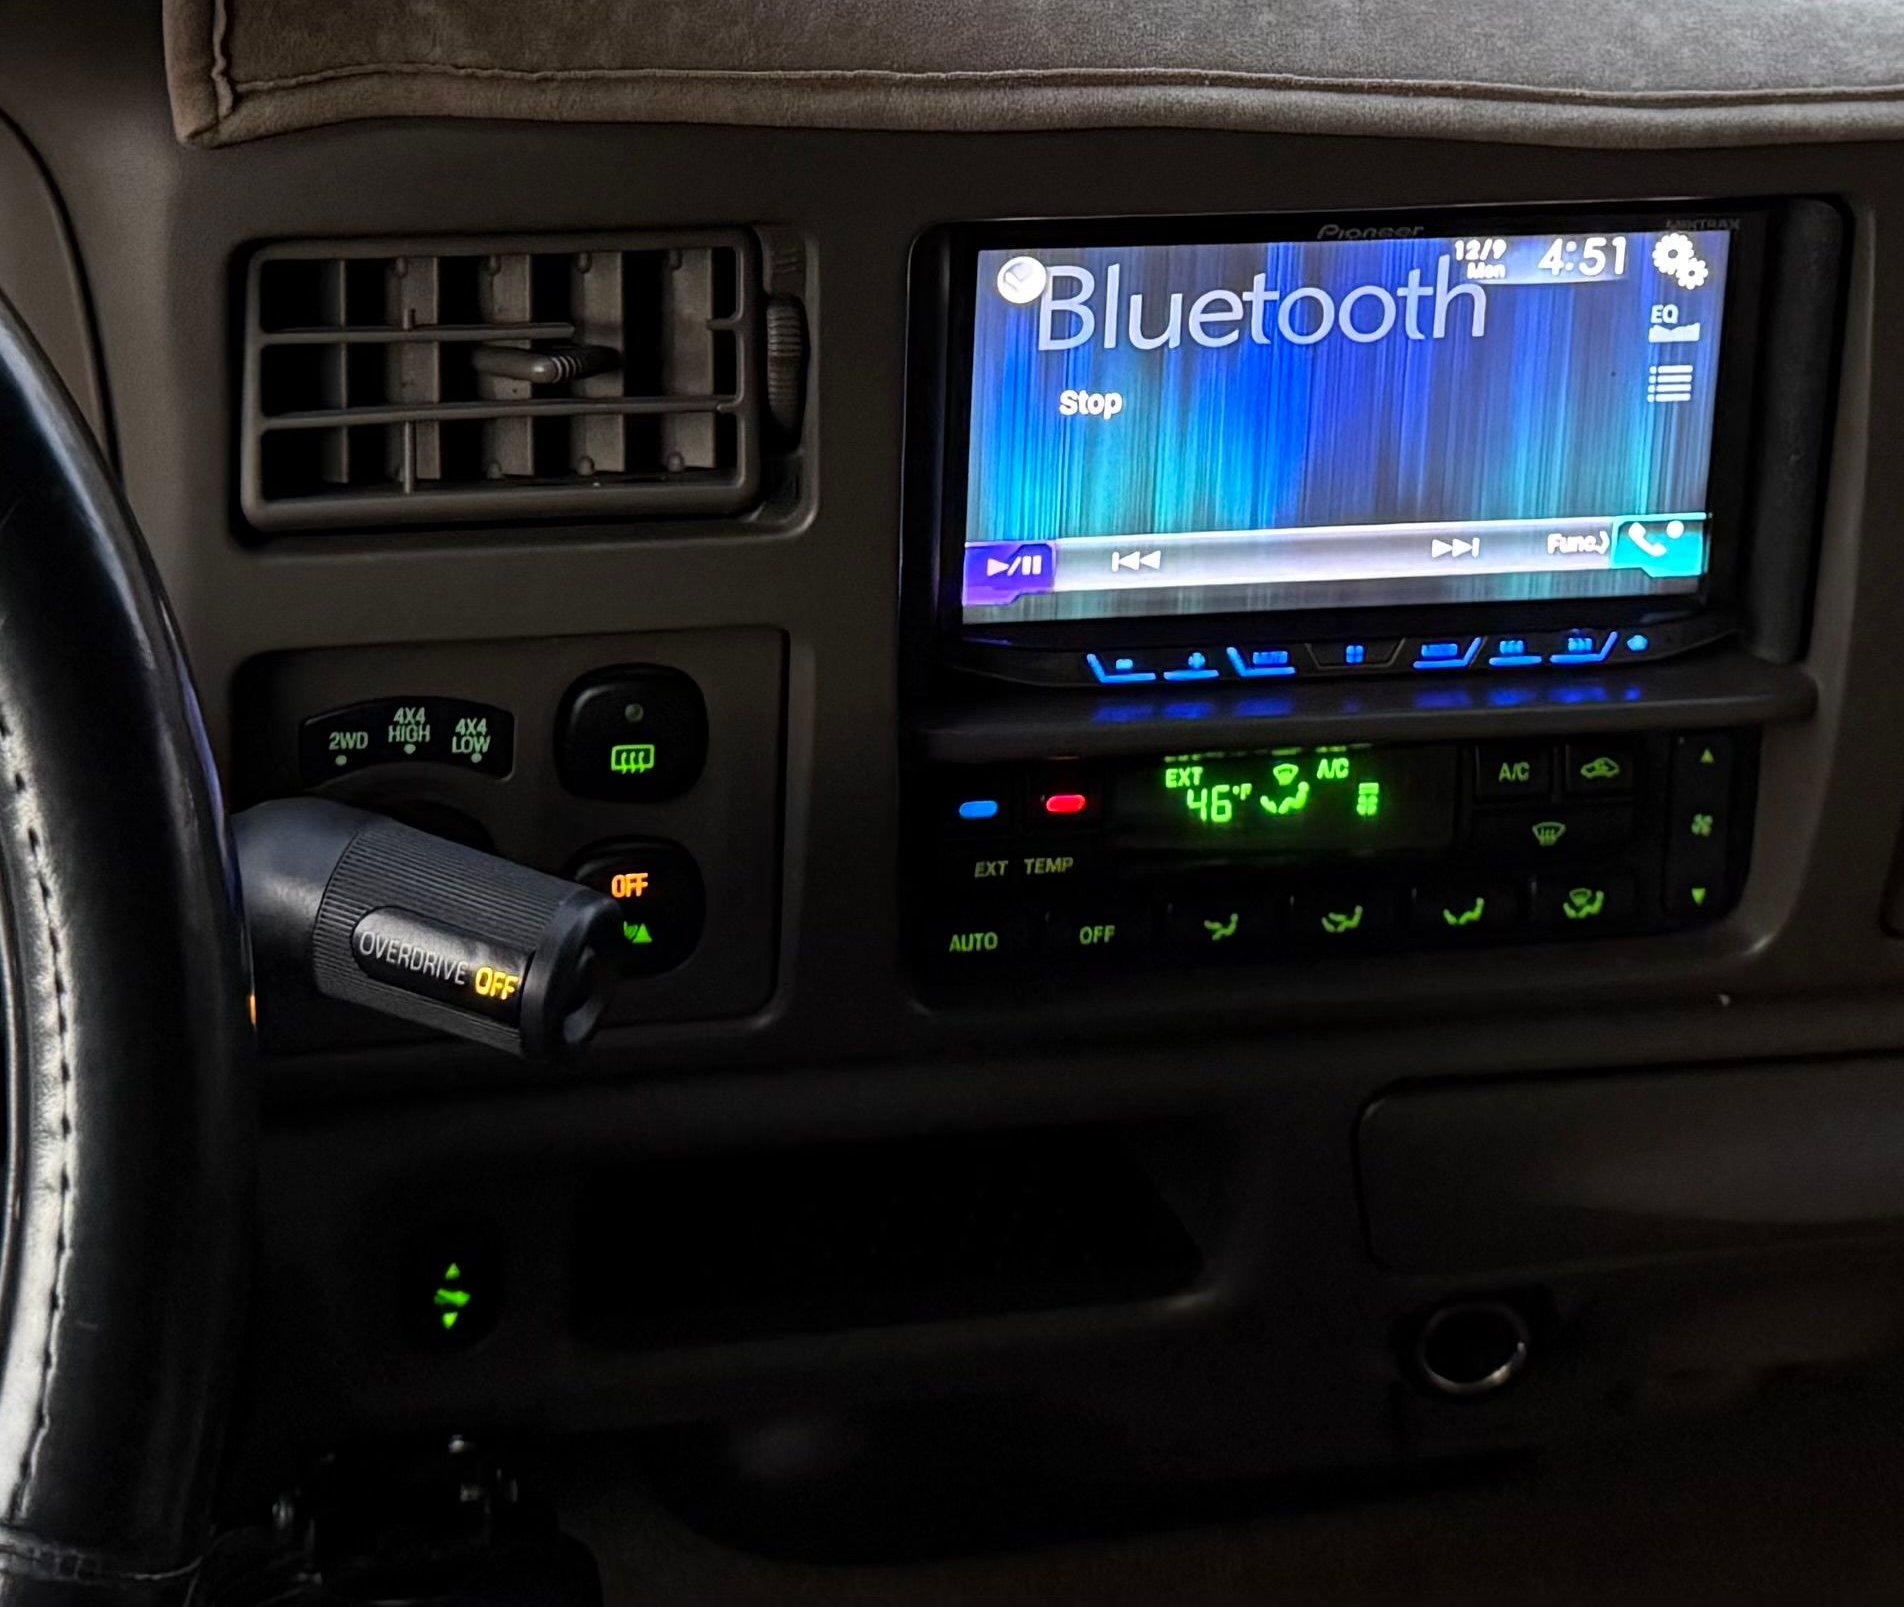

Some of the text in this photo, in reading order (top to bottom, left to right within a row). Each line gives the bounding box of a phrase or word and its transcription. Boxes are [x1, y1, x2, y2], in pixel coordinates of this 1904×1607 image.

[1454, 238, 1507, 262] 12/9
[1537, 235, 1627, 277] 4:51
[1037, 254, 1488, 352] Bluetooth
[1650, 303, 1679, 325] EQ
[1059, 389, 1123, 420] Stop
[393, 706, 426, 725] 4X4
[387, 724, 431, 743] HIGH
[455, 717, 488, 737] 4X4
[328, 731, 369, 751] 2WD
[451, 735, 491, 754] LOW
[1165, 766, 1204, 789] EXT
[1316, 757, 1350, 780] A/C
[1498, 761, 1530, 781] A/C
[974, 857, 1074, 878] EXT TEMP
[610, 872, 649, 898] OFF
[948, 932, 998, 953] AUTO
[1079, 925, 1115, 945] OFF
[359, 930, 520, 1000] OVERDRIVE OFF
